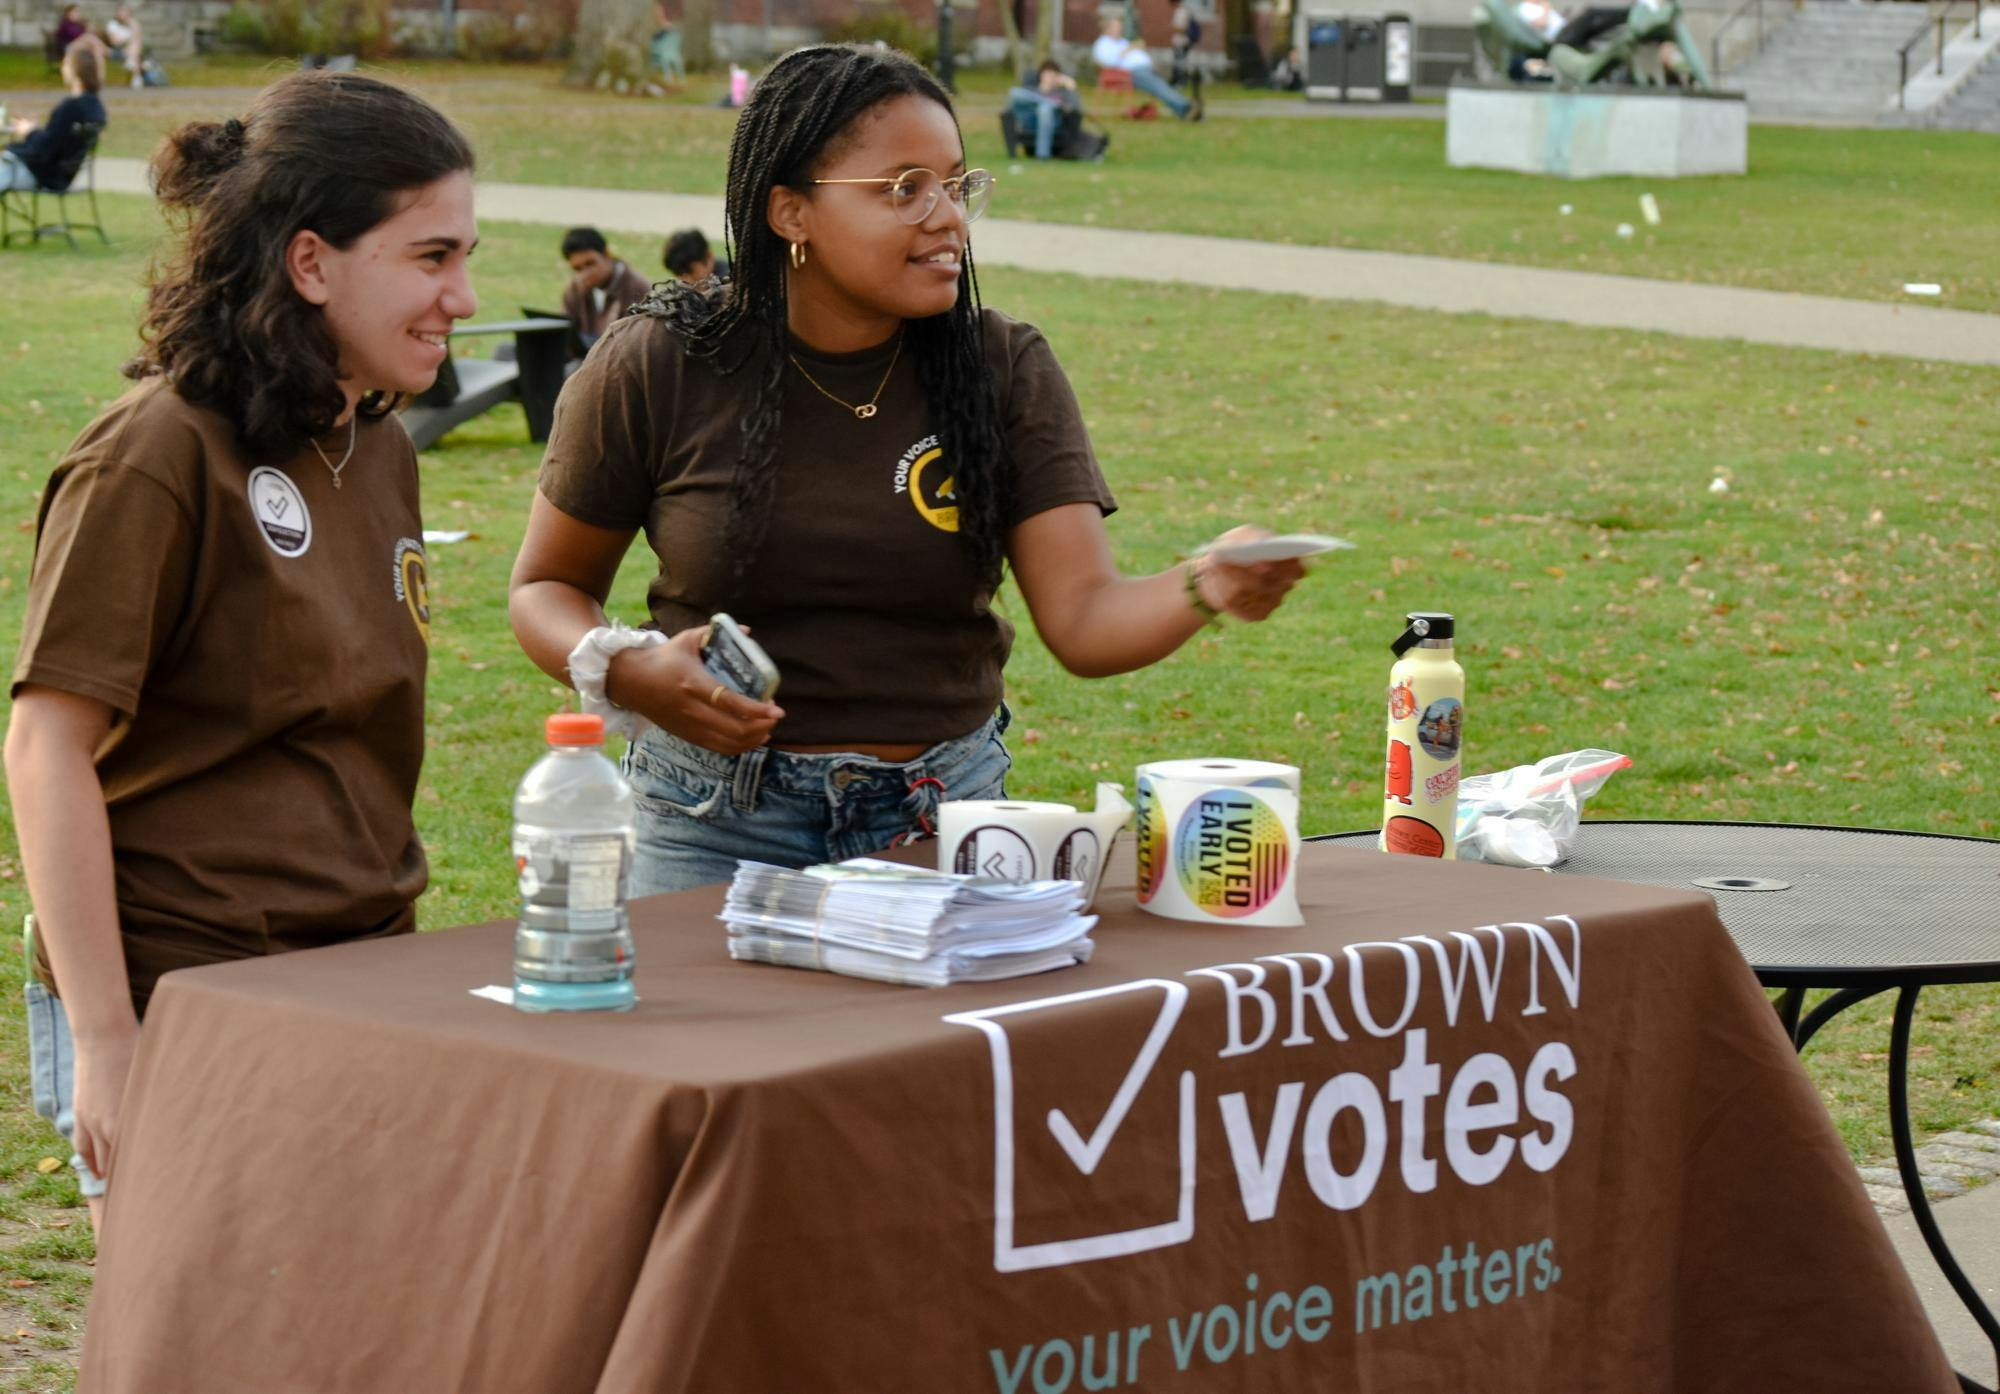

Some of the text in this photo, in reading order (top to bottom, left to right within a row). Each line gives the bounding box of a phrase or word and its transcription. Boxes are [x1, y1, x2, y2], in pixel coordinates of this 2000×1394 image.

[894, 435, 939, 494] YOUR VOICE
[1200, 800, 1223, 877] EARLY
[1225, 802, 1253, 908] I VOTED
[1184, 914, 1582, 1058] BROWN
[1217, 1027, 1578, 1223] votes
[989, 1237, 1562, 1394] your voice matters.
